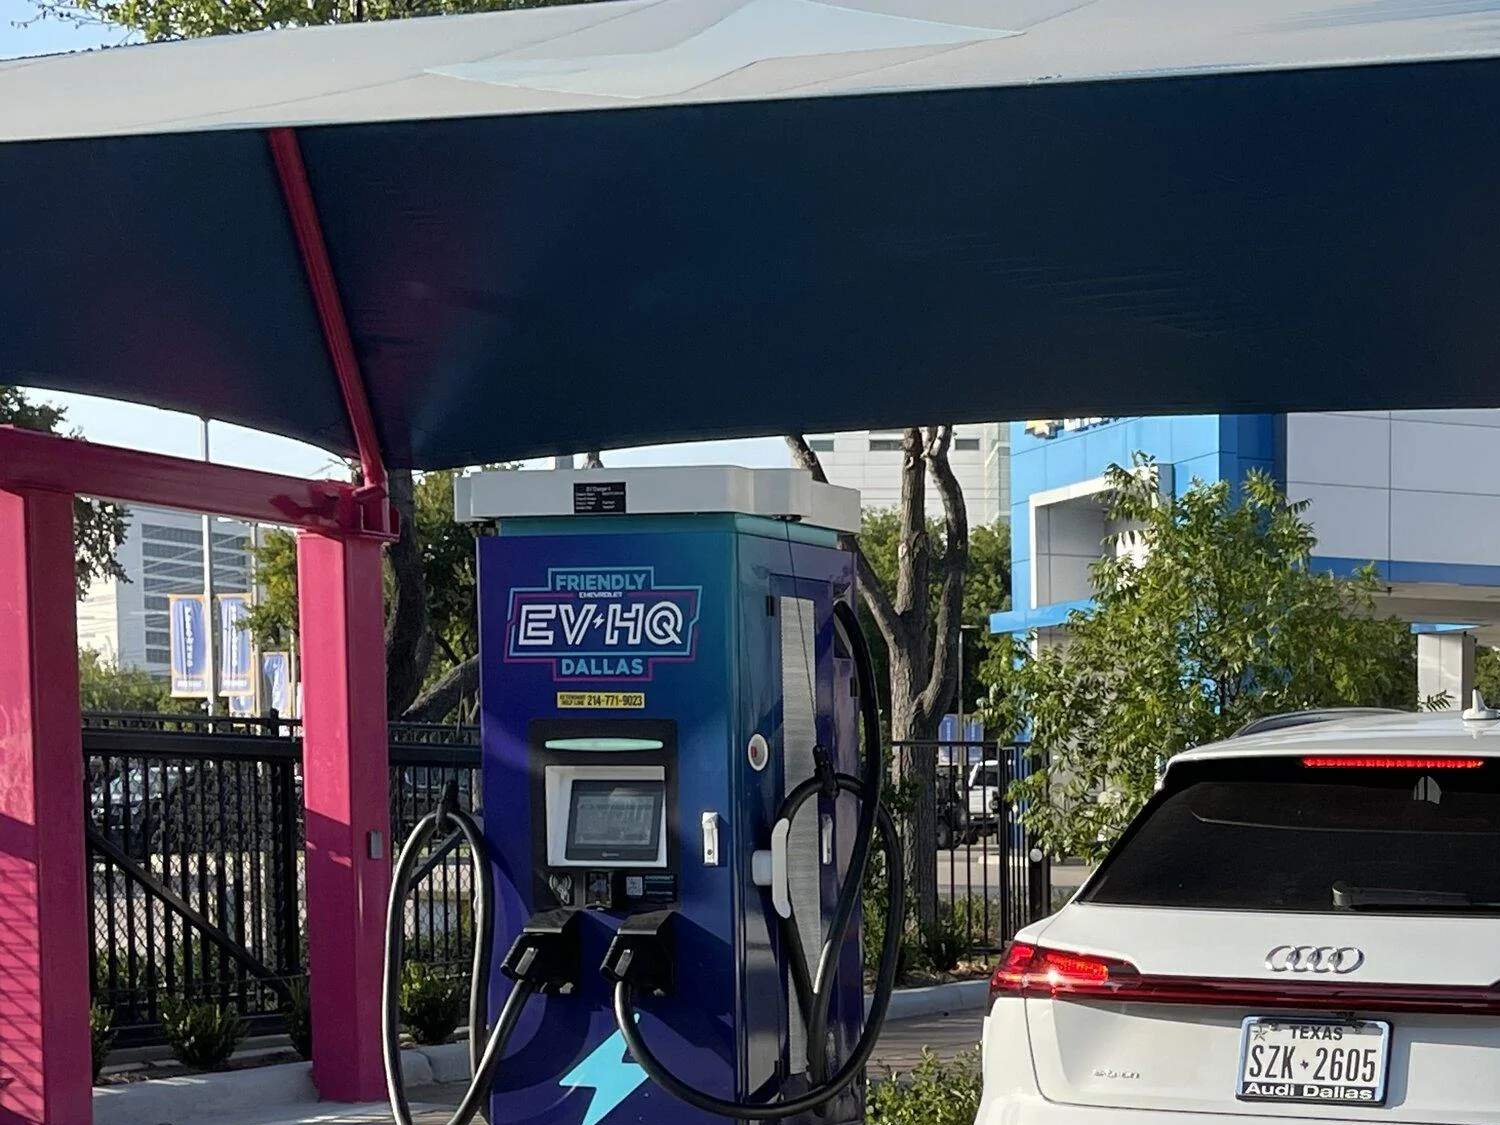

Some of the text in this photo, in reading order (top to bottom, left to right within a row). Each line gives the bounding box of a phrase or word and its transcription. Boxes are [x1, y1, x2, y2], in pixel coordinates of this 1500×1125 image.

[555, 573, 647, 591] FRIENDLY
[578, 591, 623, 599] CHEVROLET
[561, 658, 644, 676] DALLAS
[1289, 1025, 1344, 1041] TEXAS
[1244, 1082, 1373, 1100] Audi Dallas
